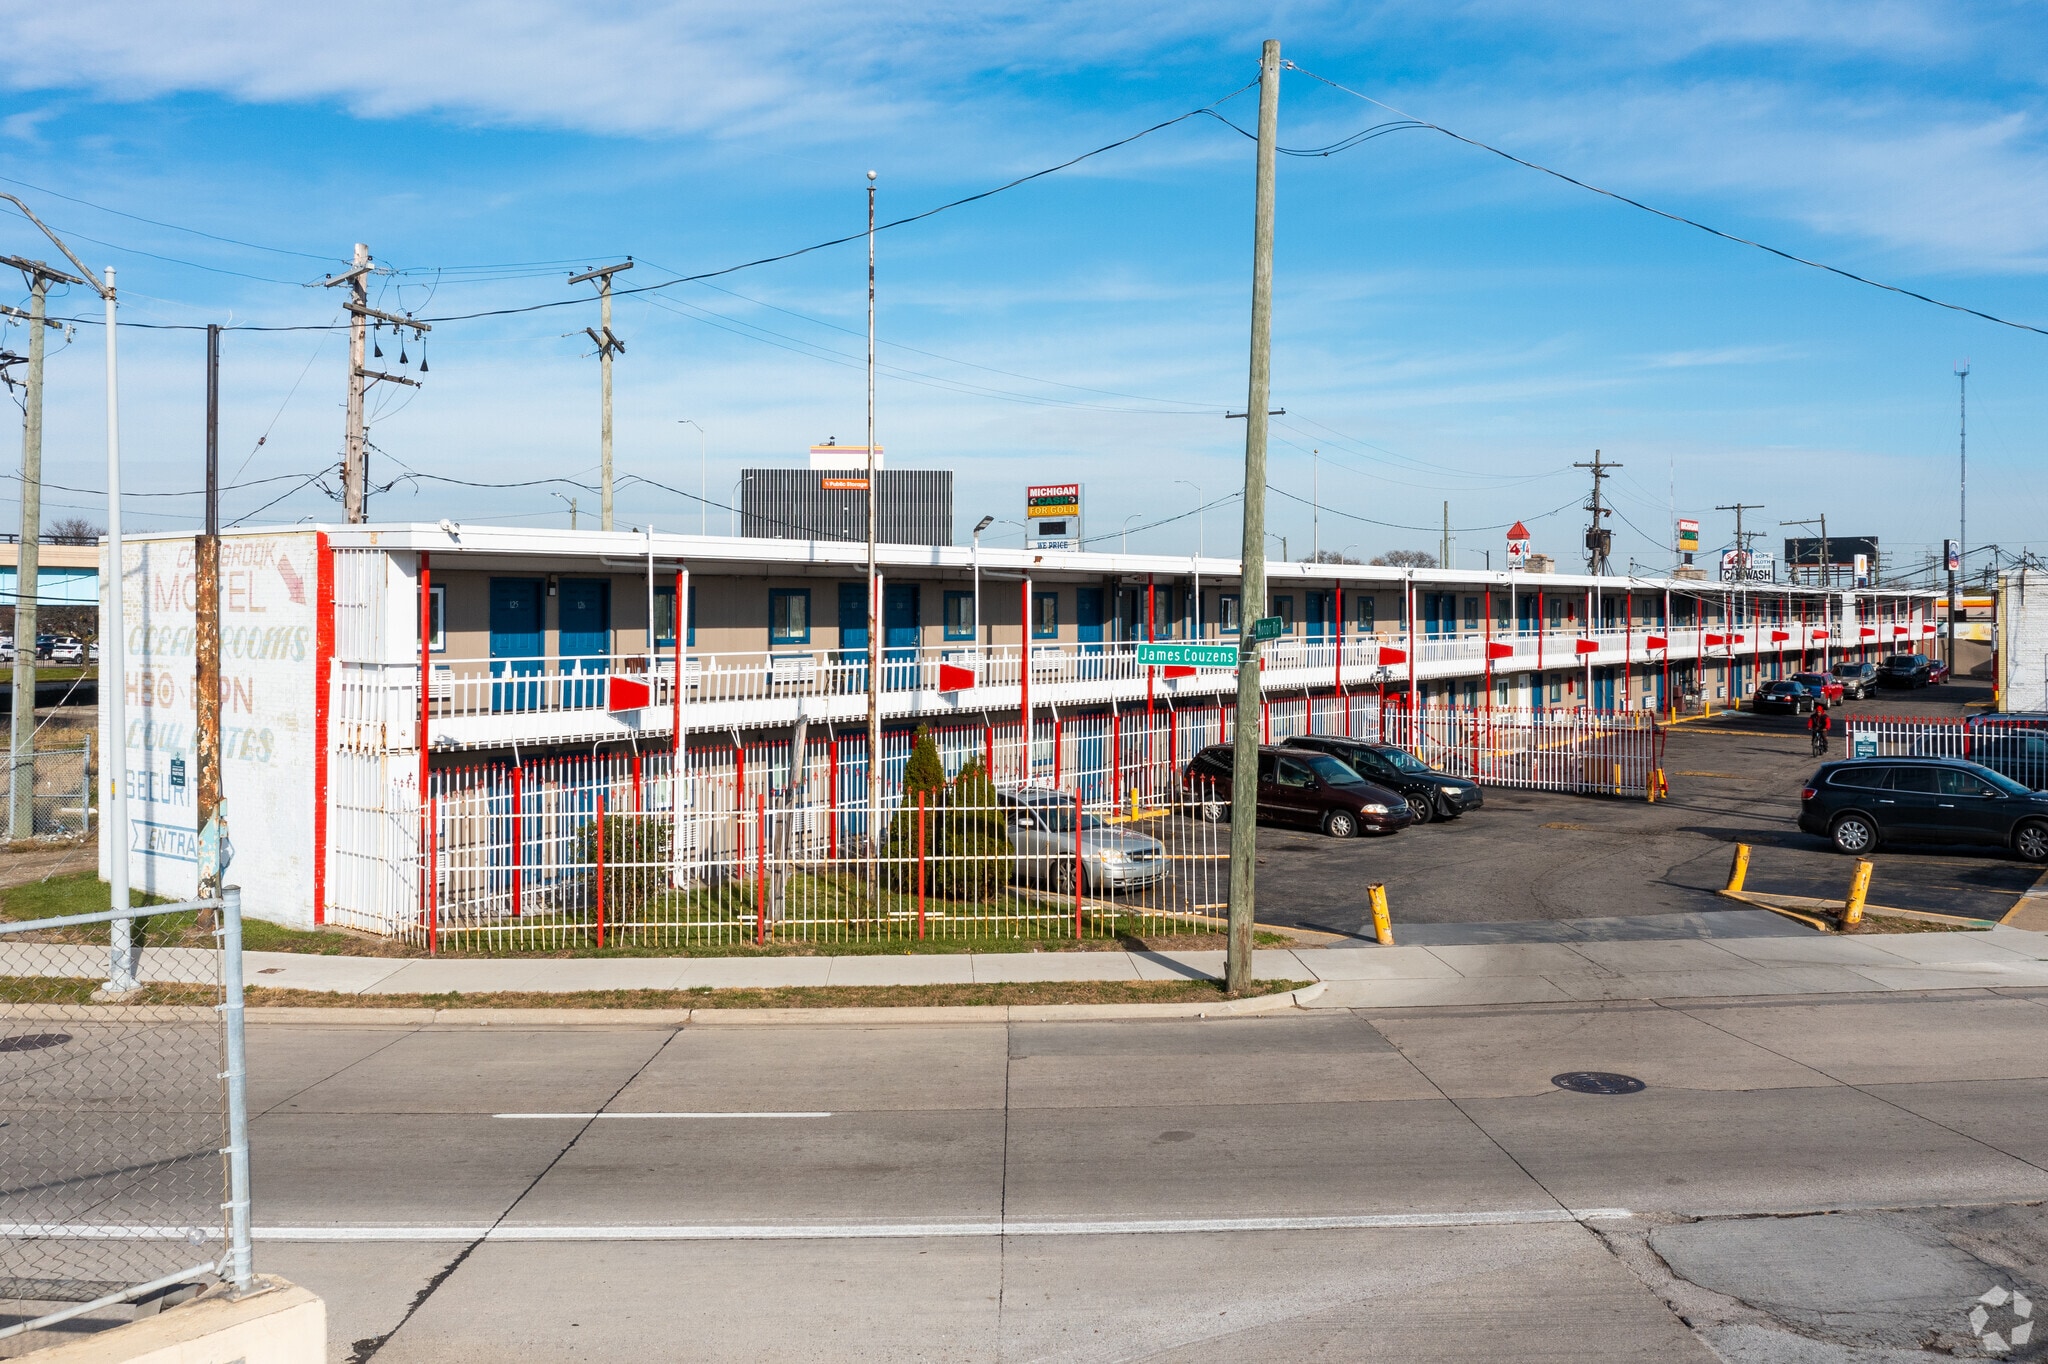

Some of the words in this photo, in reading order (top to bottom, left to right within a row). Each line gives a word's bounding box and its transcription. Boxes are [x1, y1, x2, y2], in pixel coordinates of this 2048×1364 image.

[1030, 486, 1076, 497] MICHIGAN
[1037, 496, 1069, 505] CASH
[1031, 506, 1048, 515] FOR
[1050, 505, 1075, 514] GOLD
[1746, 569, 1771, 580] WASH
[155, 570, 266, 613] MOEL
[220, 624, 309, 662] ROOMS
[1141, 647, 1180, 661] James
[1184, 649, 1234, 663] Couzens
[125, 671, 174, 709] HBO
[190, 674, 253, 714] EPN
[126, 769, 197, 807] SECURI
